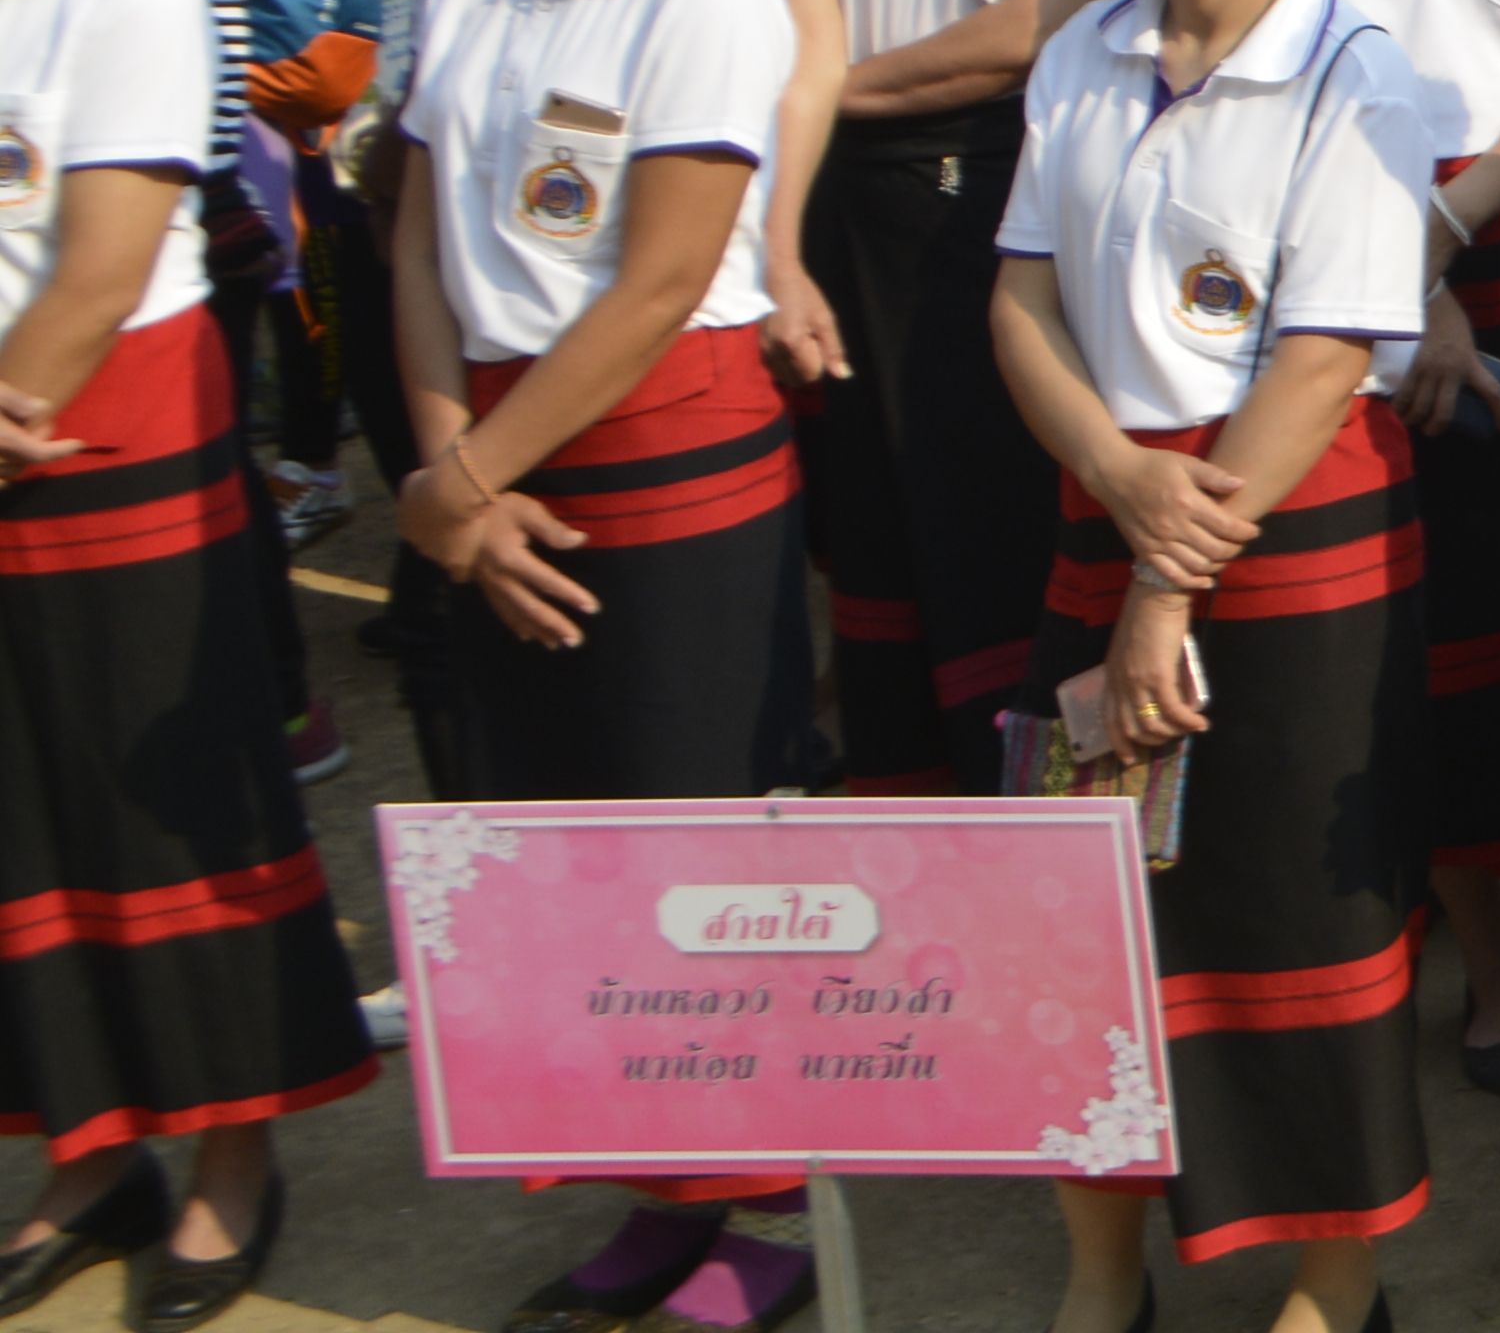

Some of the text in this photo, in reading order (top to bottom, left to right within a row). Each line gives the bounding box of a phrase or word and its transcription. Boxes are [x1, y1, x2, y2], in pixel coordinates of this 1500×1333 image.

[702, 886, 843, 945] สายใต้
[586, 975, 954, 1020] บ้านหลวง เวียงสา
[622, 1031, 940, 1087] นาน้อย นาหมื่น
